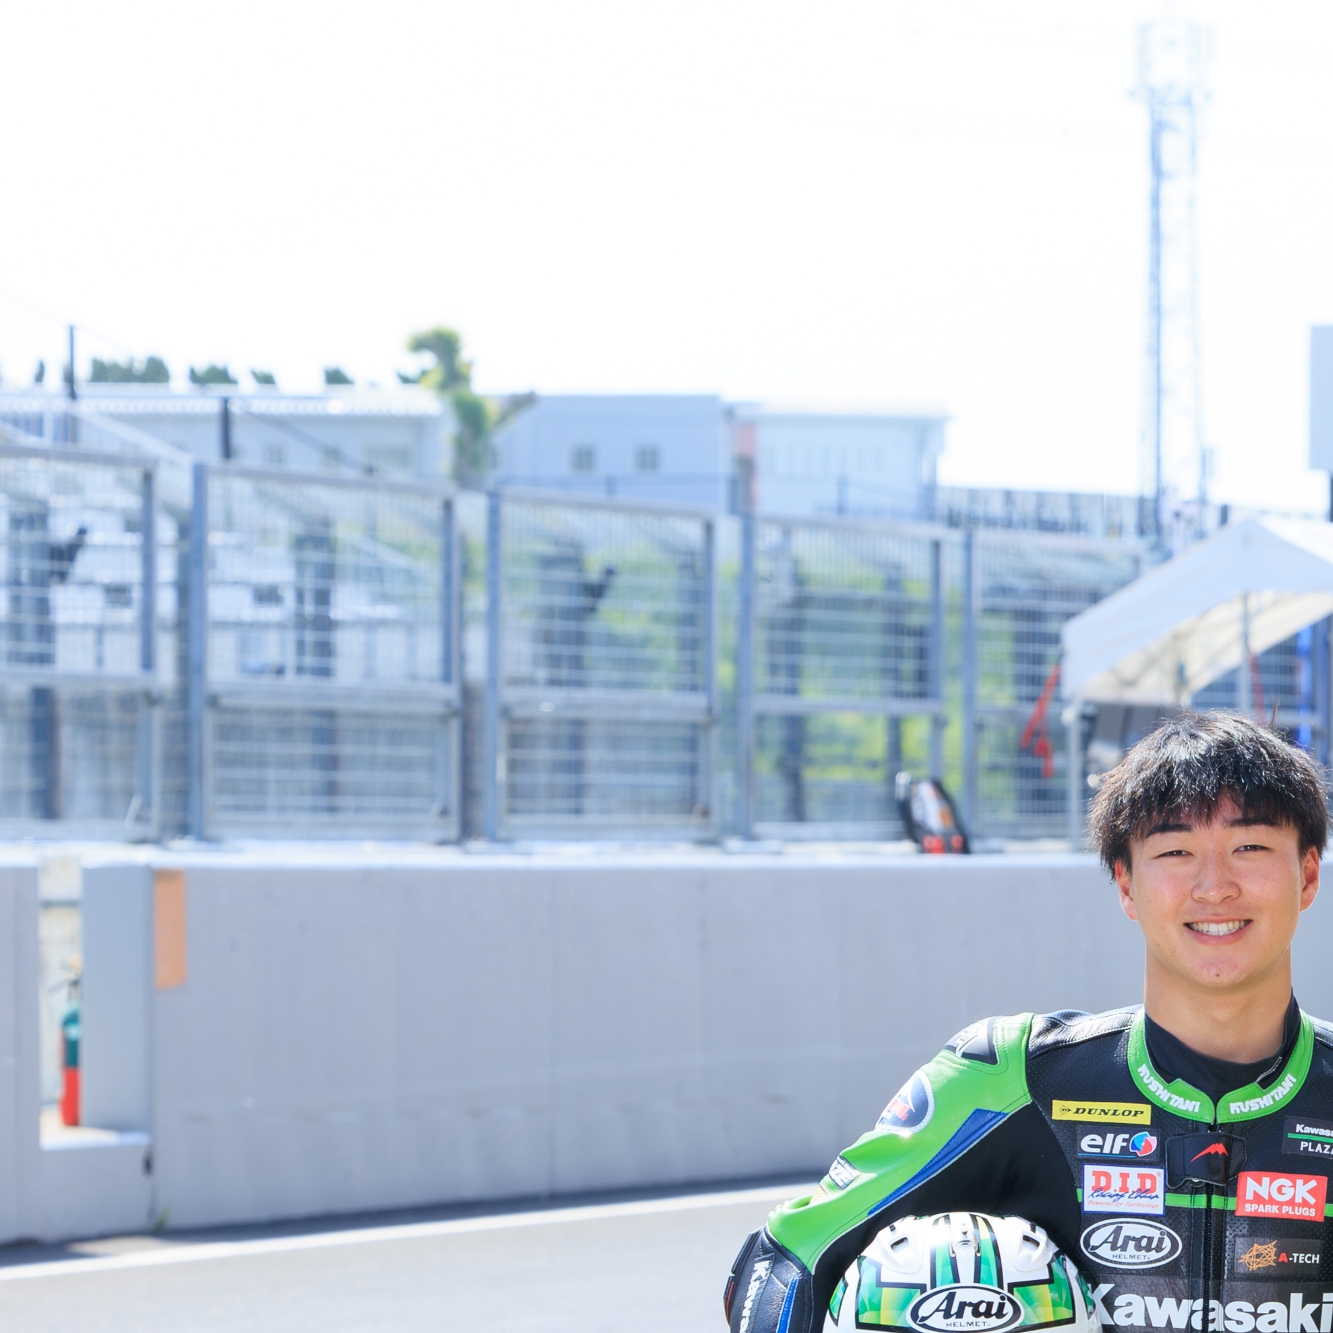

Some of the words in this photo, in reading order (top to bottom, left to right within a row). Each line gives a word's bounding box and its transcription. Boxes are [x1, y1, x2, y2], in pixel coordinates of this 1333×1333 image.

[1137, 1063, 1201, 1113] KUSHITANI
[1229, 1073, 1297, 1115] KUSHITANI
[1073, 1106, 1144, 1118] DUNLOP
[1080, 1131, 1129, 1155] elf
[1091, 1170, 1157, 1195] D.I.D
[1244, 1176, 1317, 1205] NGK
[1244, 1204, 1278, 1216] SPARK
[1281, 1205, 1316, 1217] PLUGS
[1089, 1222, 1168, 1253] Arai
[1278, 1251, 1320, 1264] A-TECH
[914, 1289, 1009, 1322] Arai
[945, 1320, 987, 1328] HELMET
